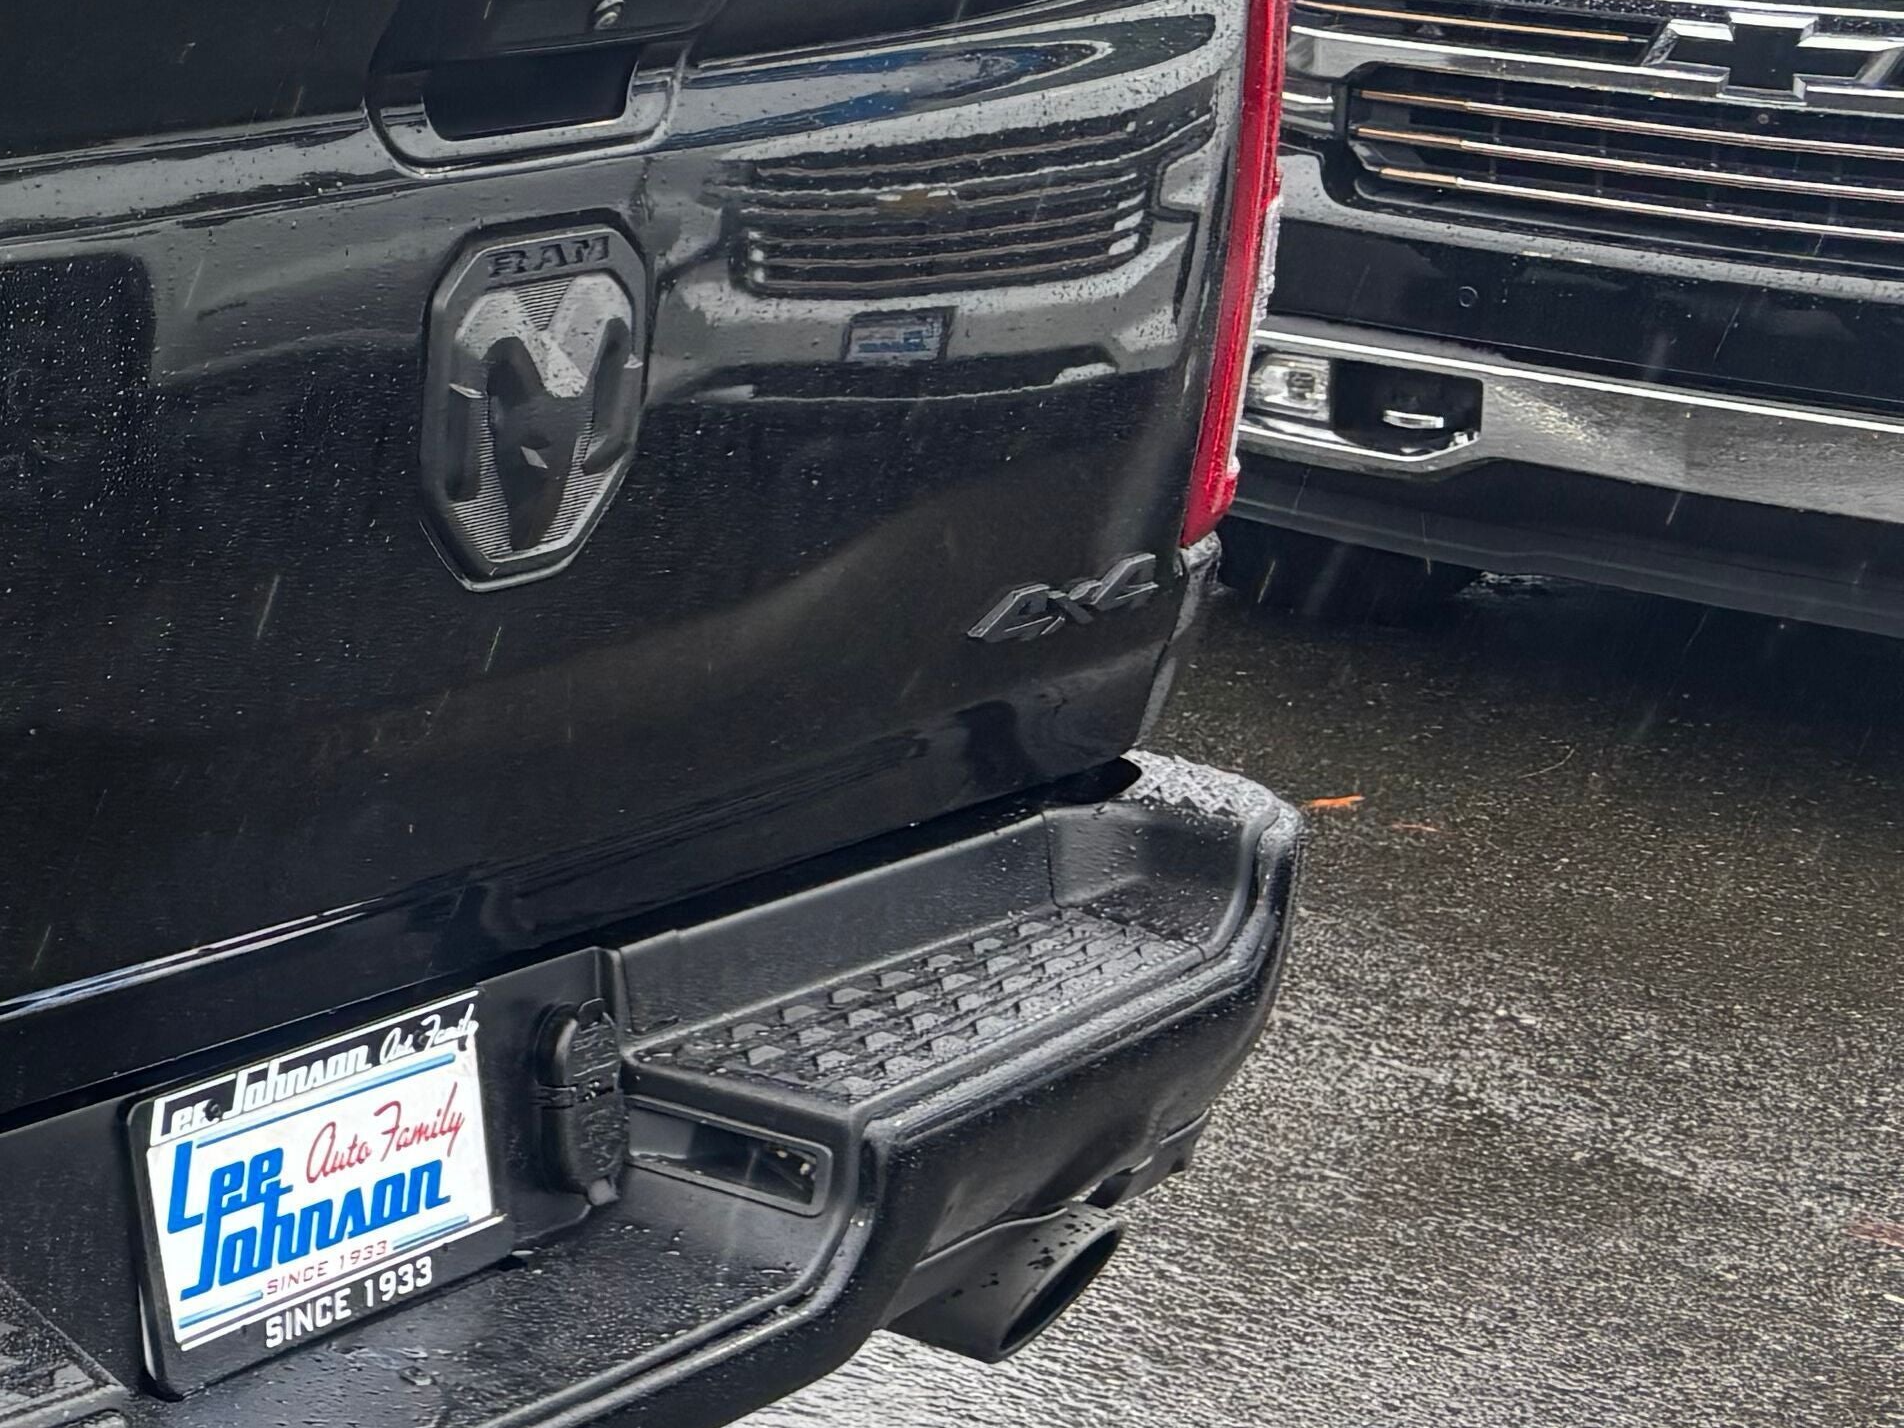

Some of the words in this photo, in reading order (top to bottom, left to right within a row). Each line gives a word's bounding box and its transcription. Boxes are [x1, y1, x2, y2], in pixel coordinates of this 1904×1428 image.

[486, 235, 610, 278] RAM
[222, 1045, 373, 1121] Johnson
[305, 1121, 372, 1184] Auto
[373, 1081, 466, 1163] Family
[166, 1140, 293, 1234] Lee
[179, 1159, 451, 1302] Johnson
[265, 1260, 329, 1296] SINCE
[339, 1239, 388, 1274] 1933
[265, 1286, 352, 1349] SINCE
[363, 1255, 433, 1307] 1933
